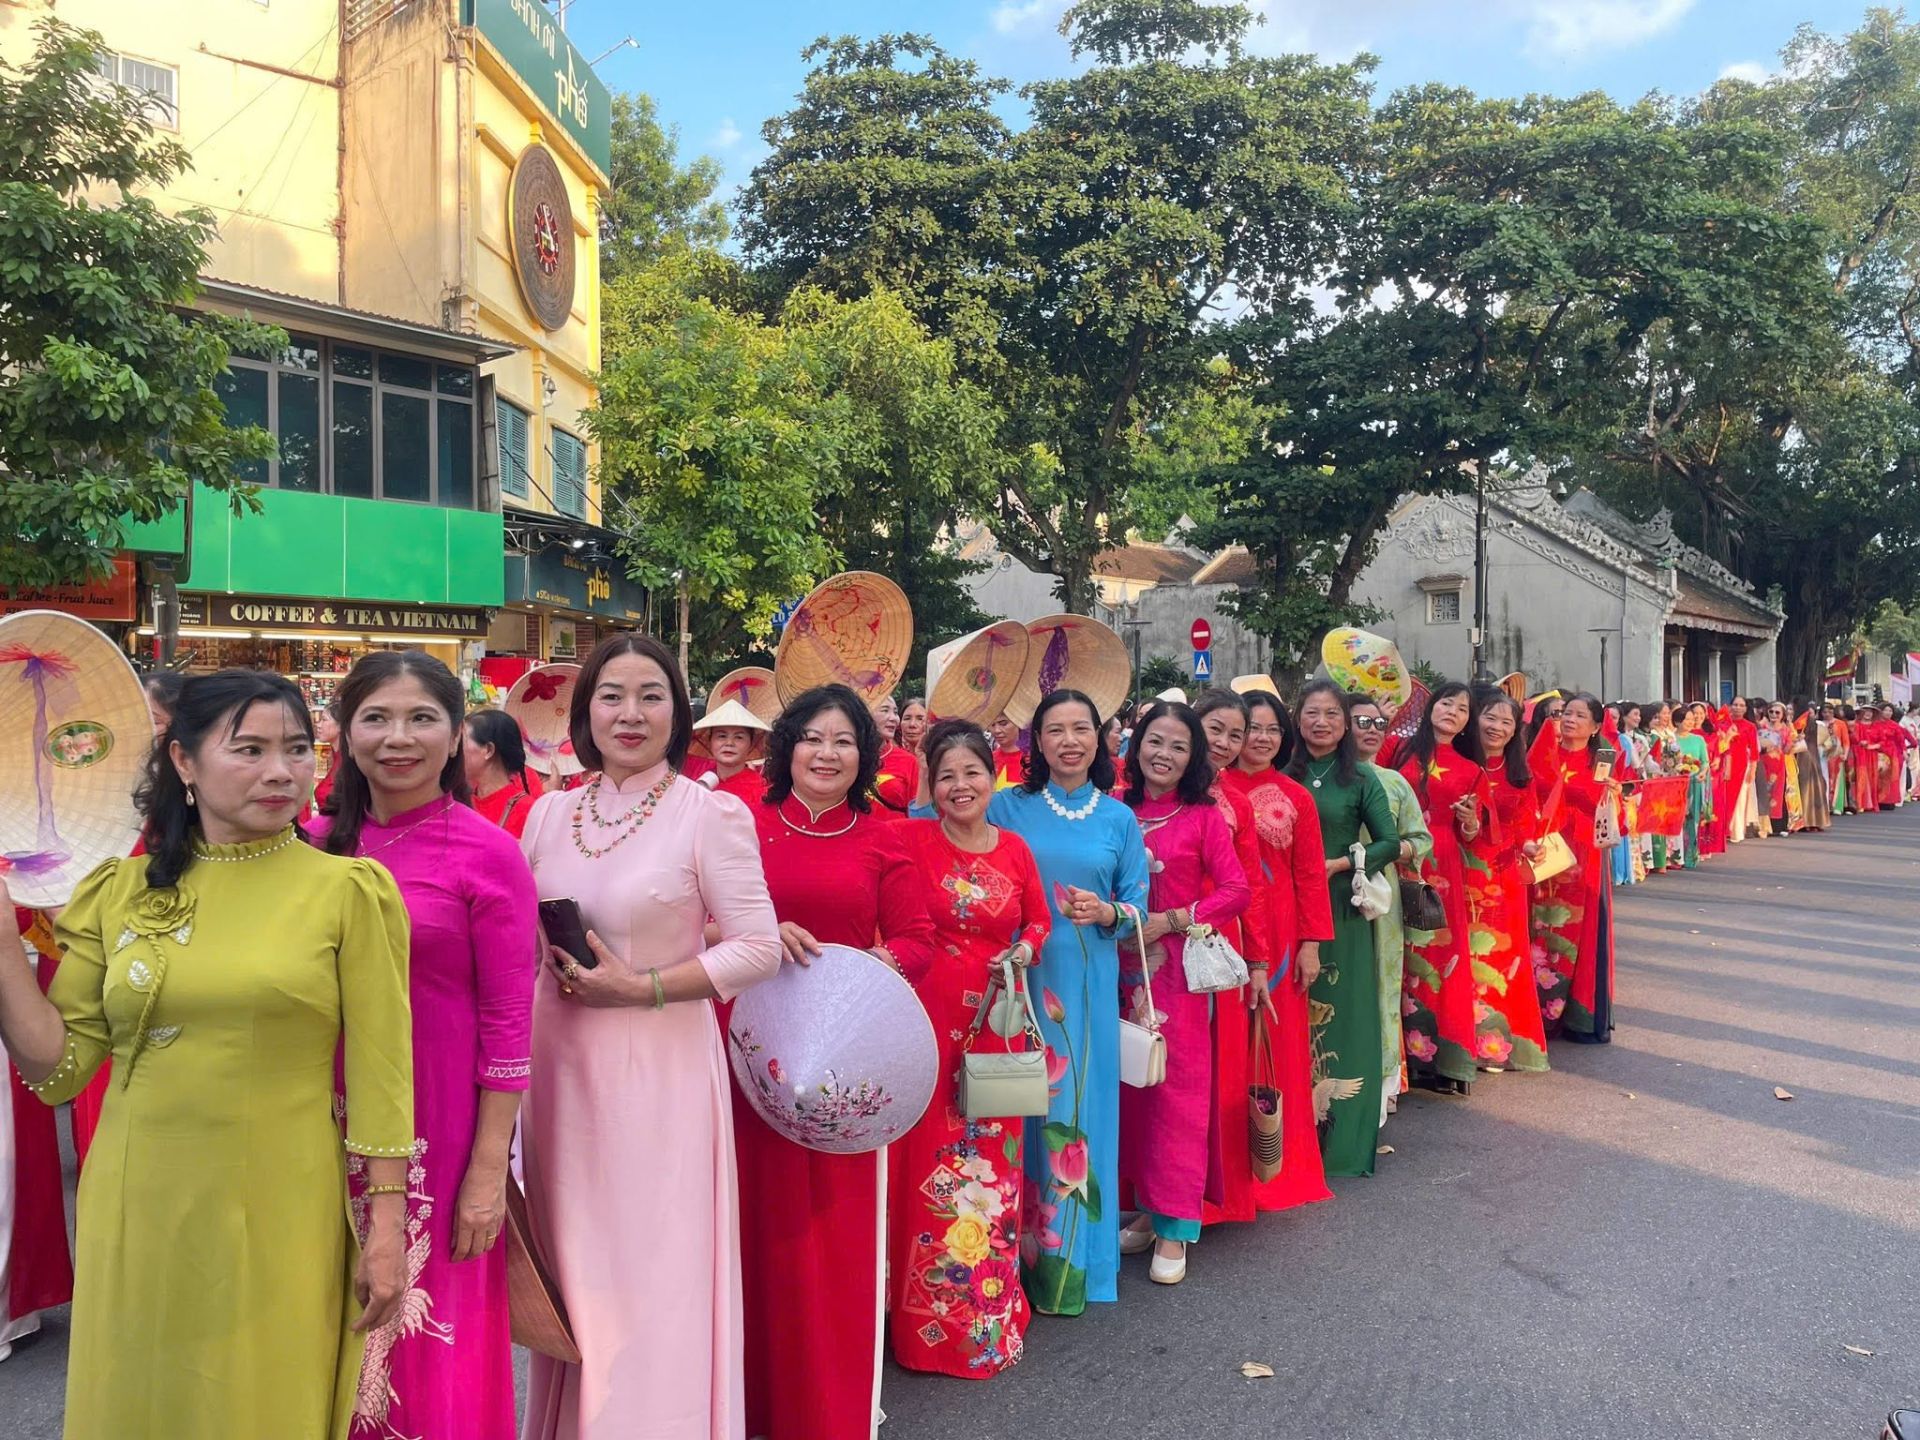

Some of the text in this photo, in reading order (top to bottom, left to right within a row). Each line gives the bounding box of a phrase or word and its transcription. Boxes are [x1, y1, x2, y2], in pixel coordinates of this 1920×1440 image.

[230, 603, 478, 630] COFFEE & TEA VIETNAM
